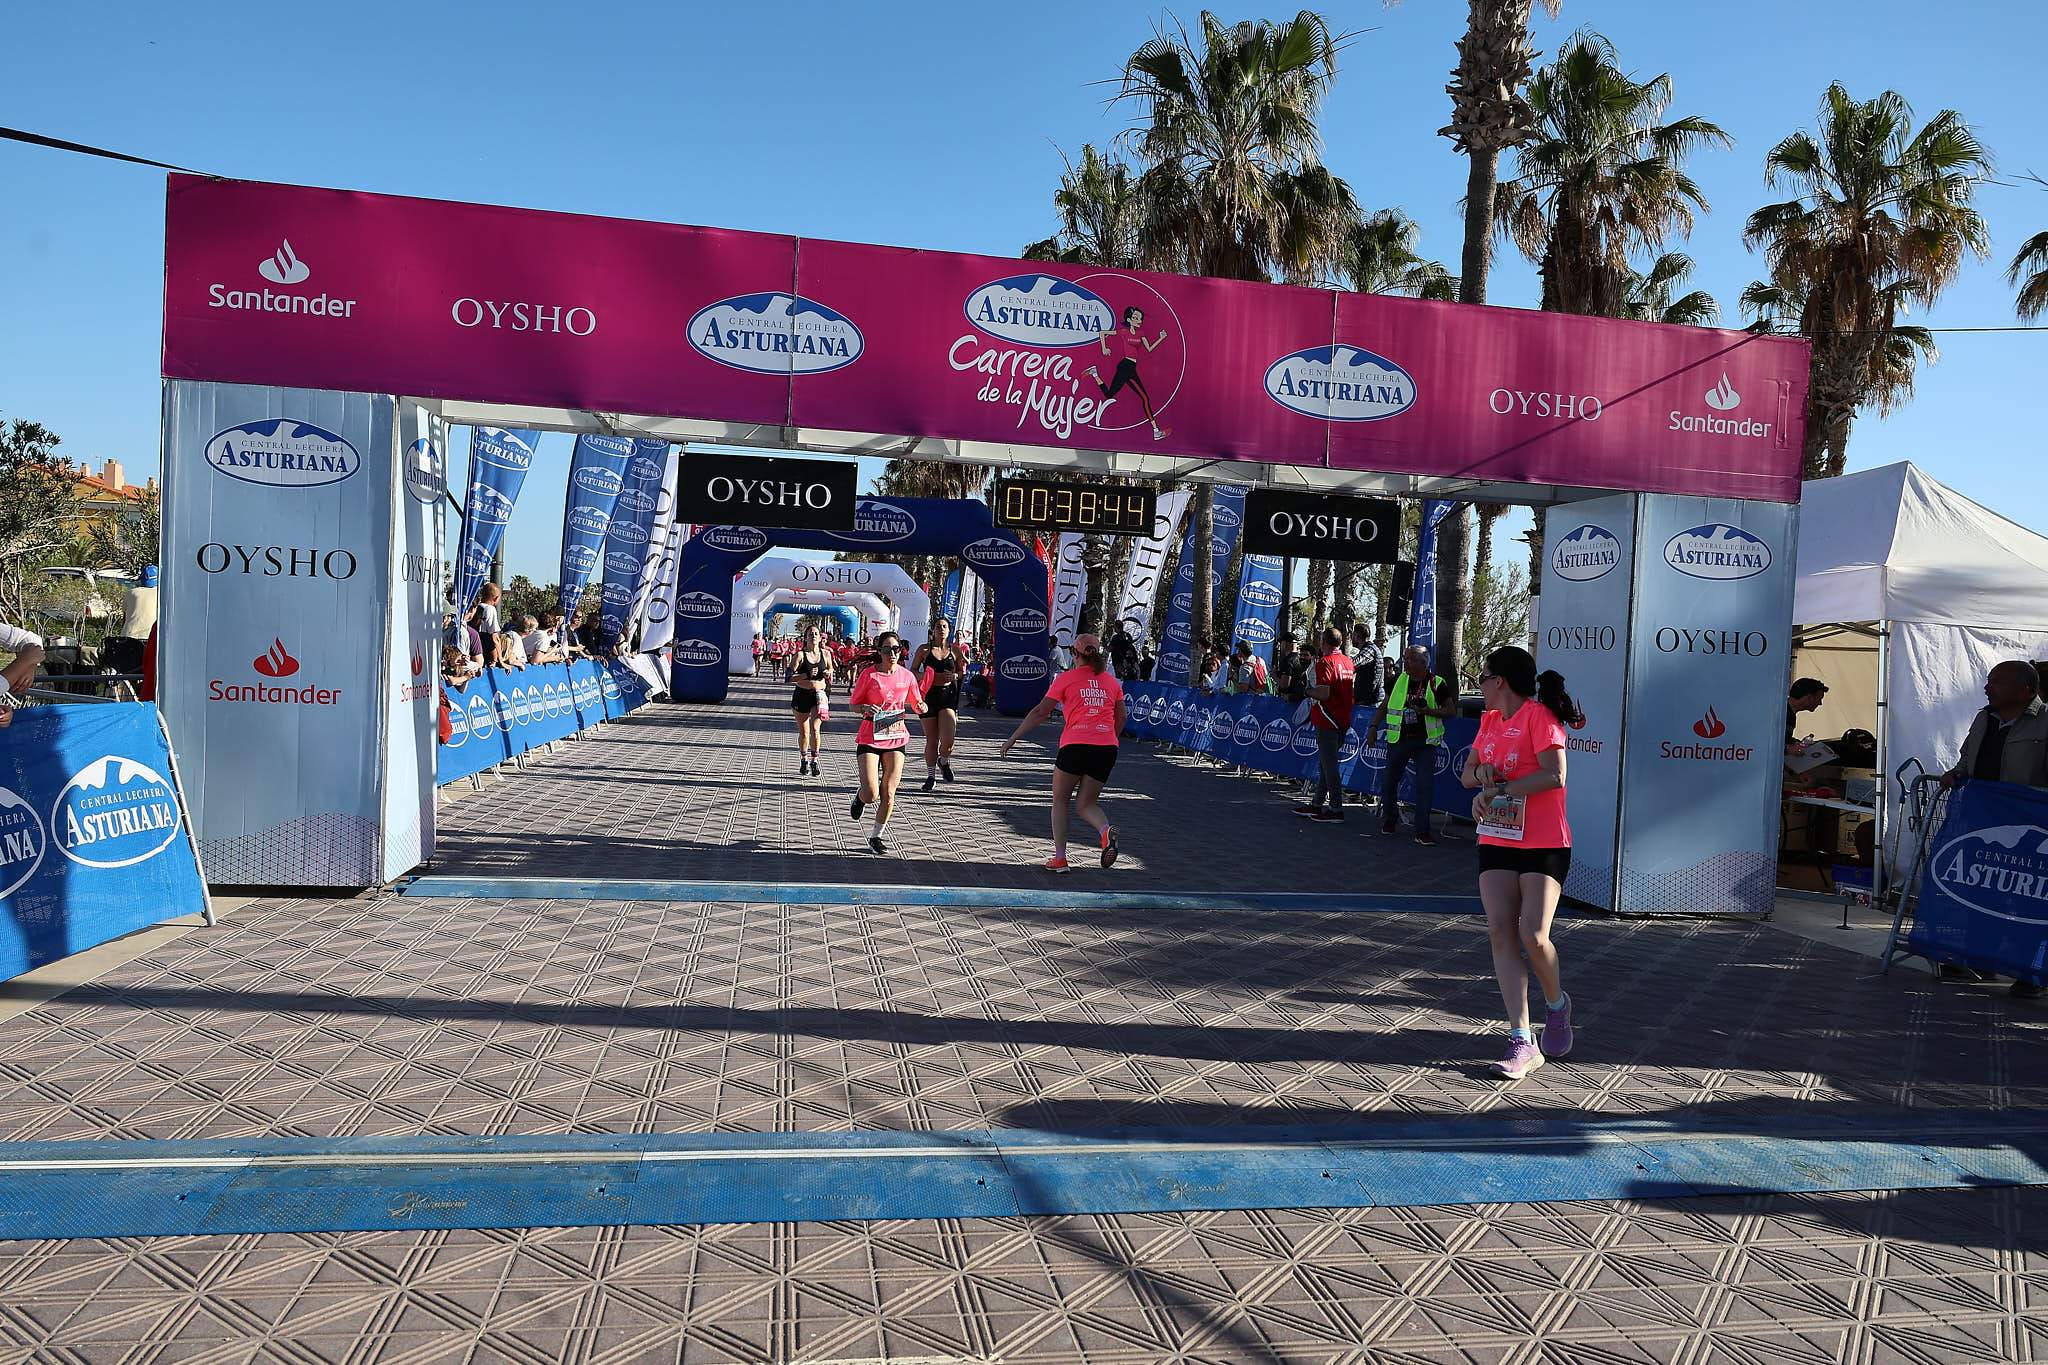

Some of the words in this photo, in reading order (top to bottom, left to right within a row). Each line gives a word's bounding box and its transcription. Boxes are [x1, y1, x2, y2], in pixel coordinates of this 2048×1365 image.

[208, 284, 356, 318] Santander
[976, 295, 1101, 333] ASTURIANA
[1000, 295, 1048, 307] CENTRAL
[1051, 300, 1101, 312] LECHERA
[451, 297, 597, 336] OYSHO
[728, 316, 785, 329] CENTRAL
[700, 317, 851, 358] ASTURIANA
[948, 334, 1073, 380] Carrera
[1276, 367, 1404, 405] ASTURIANA
[1300, 367, 1348, 379] CENTRAL
[1352, 372, 1401, 383] LECHERA
[977, 378, 1001, 402] de
[1005, 376, 1023, 405] la
[1016, 378, 1117, 439] Mujer
[1489, 388, 1603, 421] OYSHO
[1669, 411, 1772, 437] Santander
[217, 440, 349, 473] ASTURIANA
[241, 439, 291, 450] CENTRAL
[294, 443, 344, 453] LECHERA
[707, 476, 832, 509] OYSHO
[1006, 487, 1144, 526] 00:38:44
[707, 531, 762, 546] ASTURIANA
[854, 517, 908, 534] URIANA
[1270, 511, 1378, 542] OYSHO
[968, 548, 1021, 560] ASTURIANA
[1555, 548, 1615, 569] ASTURIANA
[1671, 542, 1763, 568] ASTURIANA
[1688, 541, 1725, 551] CENTRAL
[196, 542, 357, 580] OYSHO
[402, 552, 440, 585] OYSHO
[647, 528, 679, 623] OYSH
[792, 564, 872, 585] OYSHO
[1121, 515, 1172, 643] OYSHO
[677, 601, 721, 614] ASTURIANA
[1547, 625, 1616, 651] OYSHO
[1656, 627, 1768, 656] OYSHO
[674, 648, 718, 661] ASTURIANA
[209, 680, 342, 705] Santander
[1080, 688, 1108, 698] DORSAL
[1088, 680, 1098, 688] TU
[1563, 734, 1604, 754] tander
[1660, 741, 1753, 761] Santander
[80, 795, 124, 809] CENTRAL
[66, 802, 175, 848] ASTURIANA
[1975, 850, 2032, 868] CENTRAL
[1940, 848, 2048, 901] ASTURI
